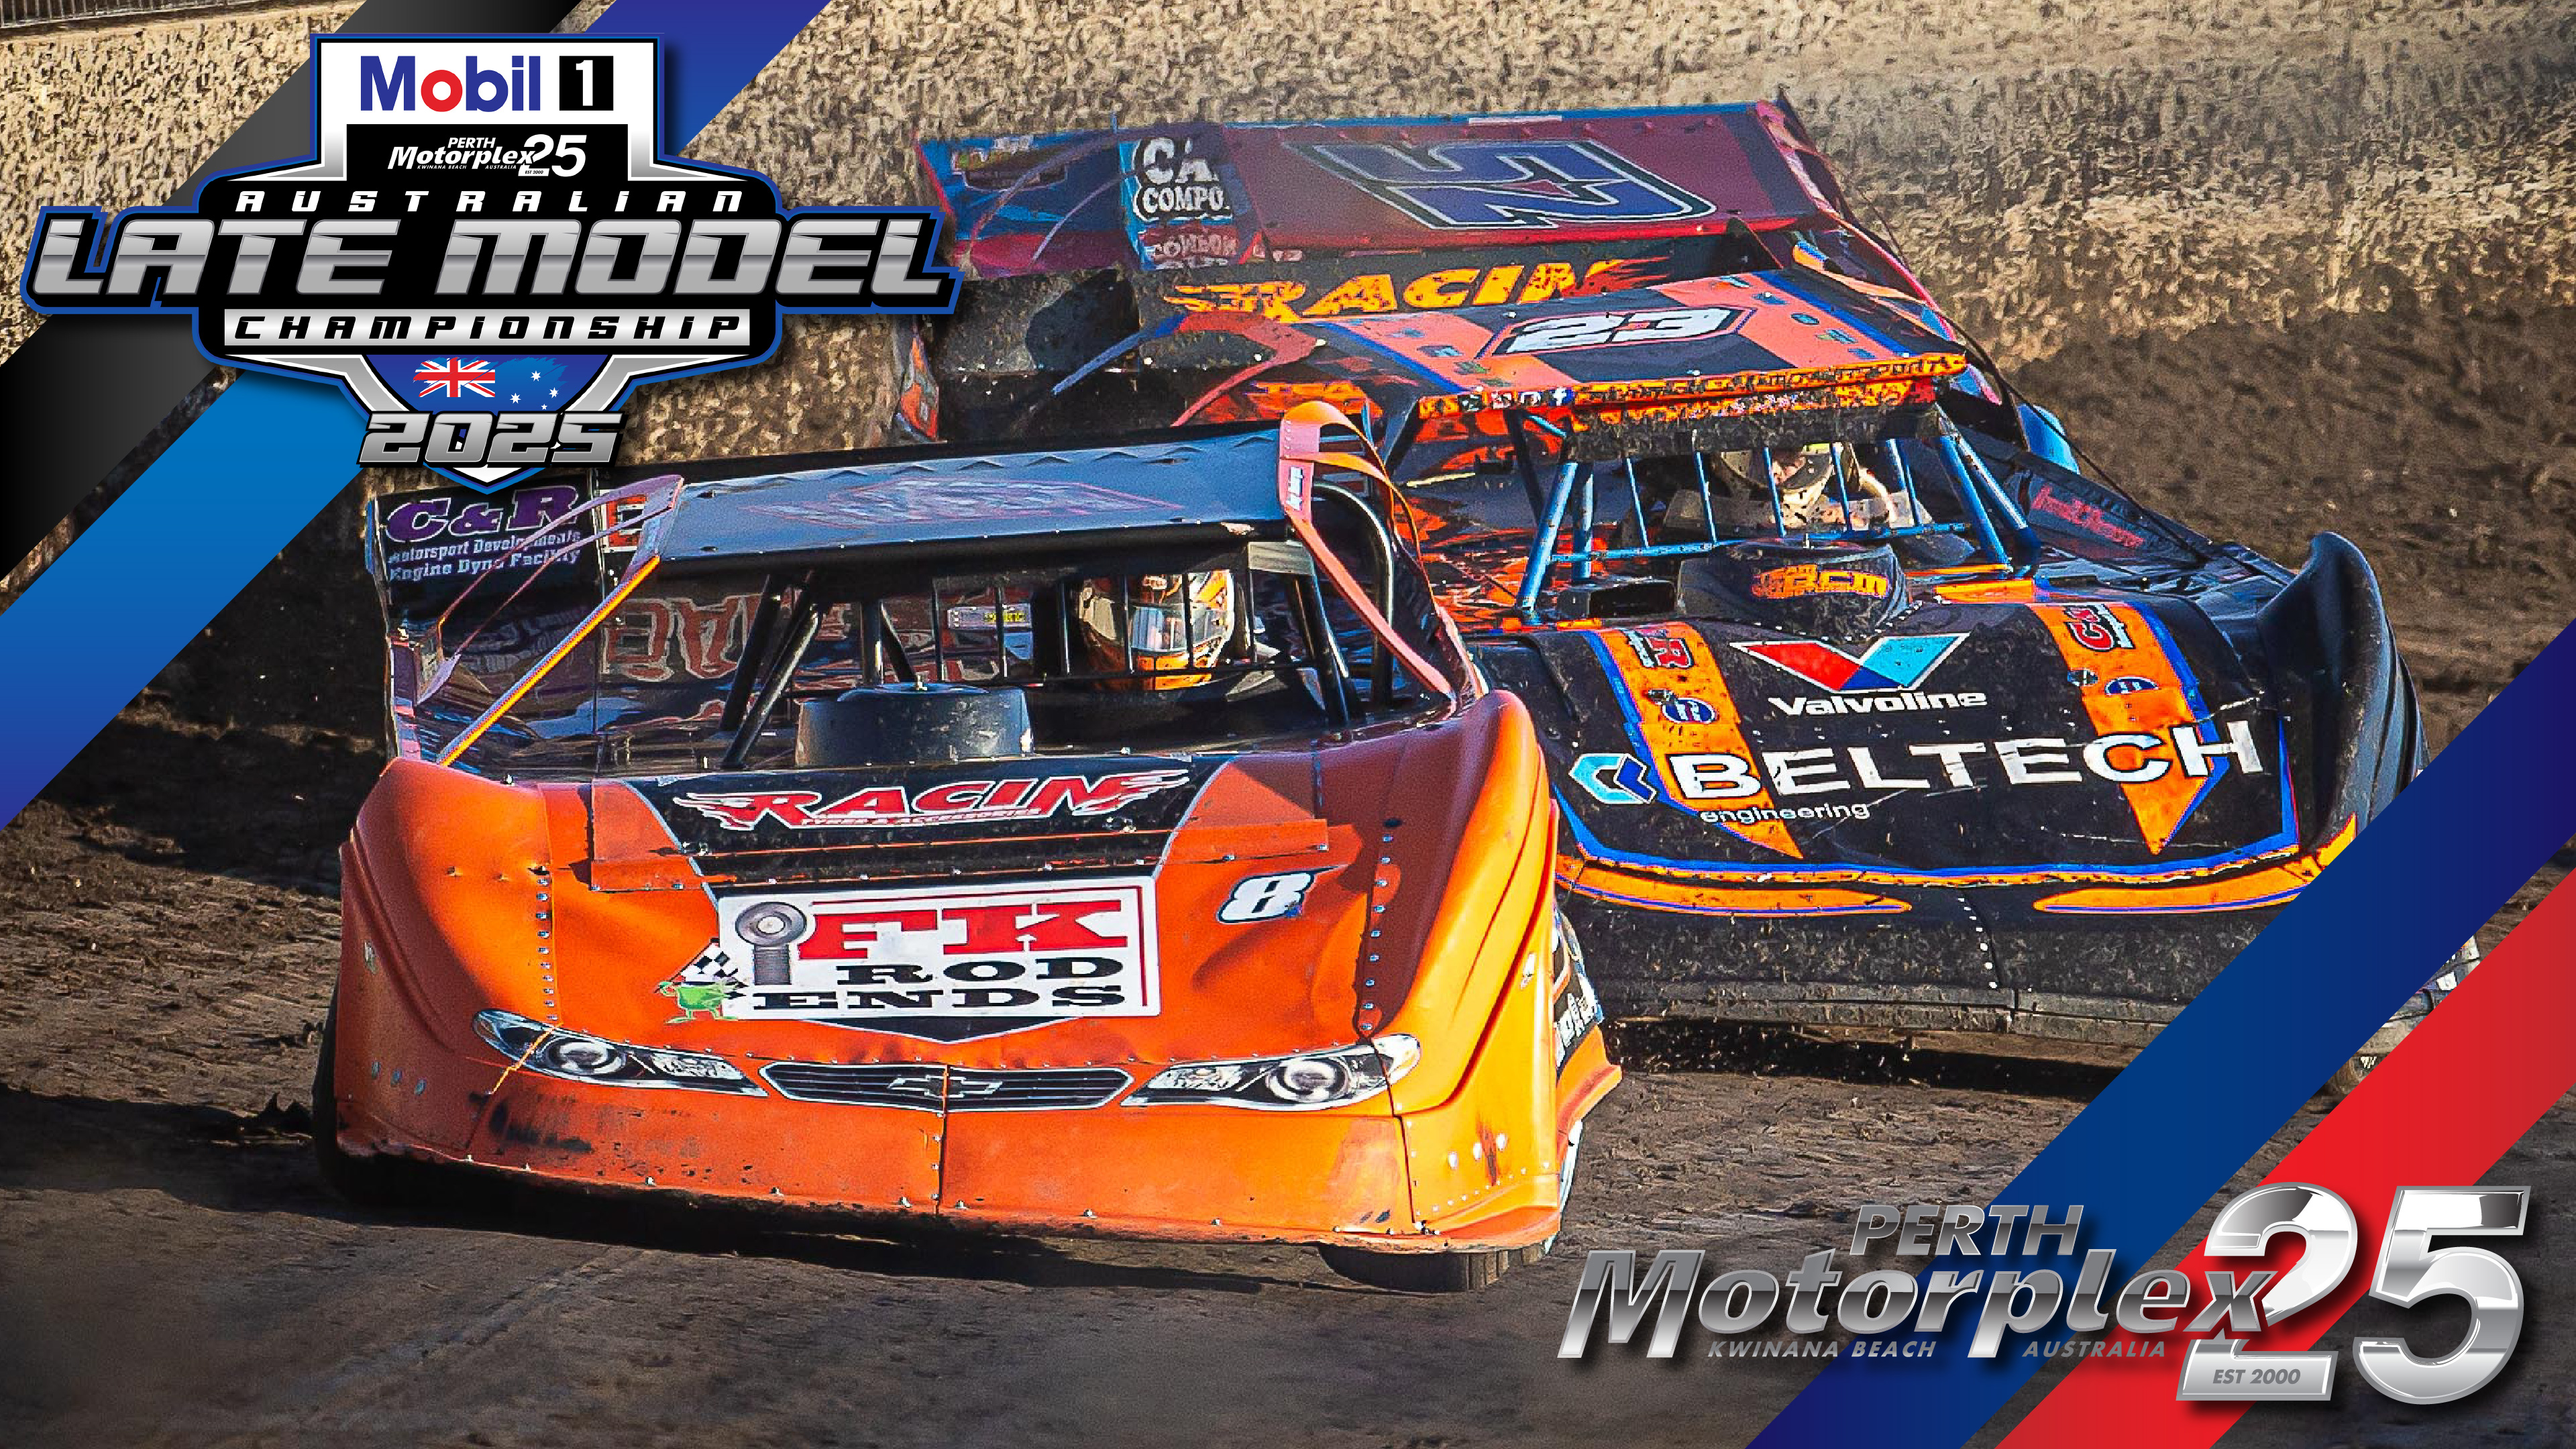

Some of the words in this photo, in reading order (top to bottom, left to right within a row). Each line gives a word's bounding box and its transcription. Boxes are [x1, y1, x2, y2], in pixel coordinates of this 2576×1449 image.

[1505, 307, 1735, 354] 23
[386, 486, 580, 542] C&R
[1768, 691, 1987, 716] Valvoline
[1669, 720, 2264, 799] BELTECH
[1700, 802, 1871, 824] engineering
[1218, 872, 1315, 924] 8
[798, 900, 1128, 960] FK
[836, 957, 1124, 986] ROD
[753, 985, 1126, 1010] ENDS
